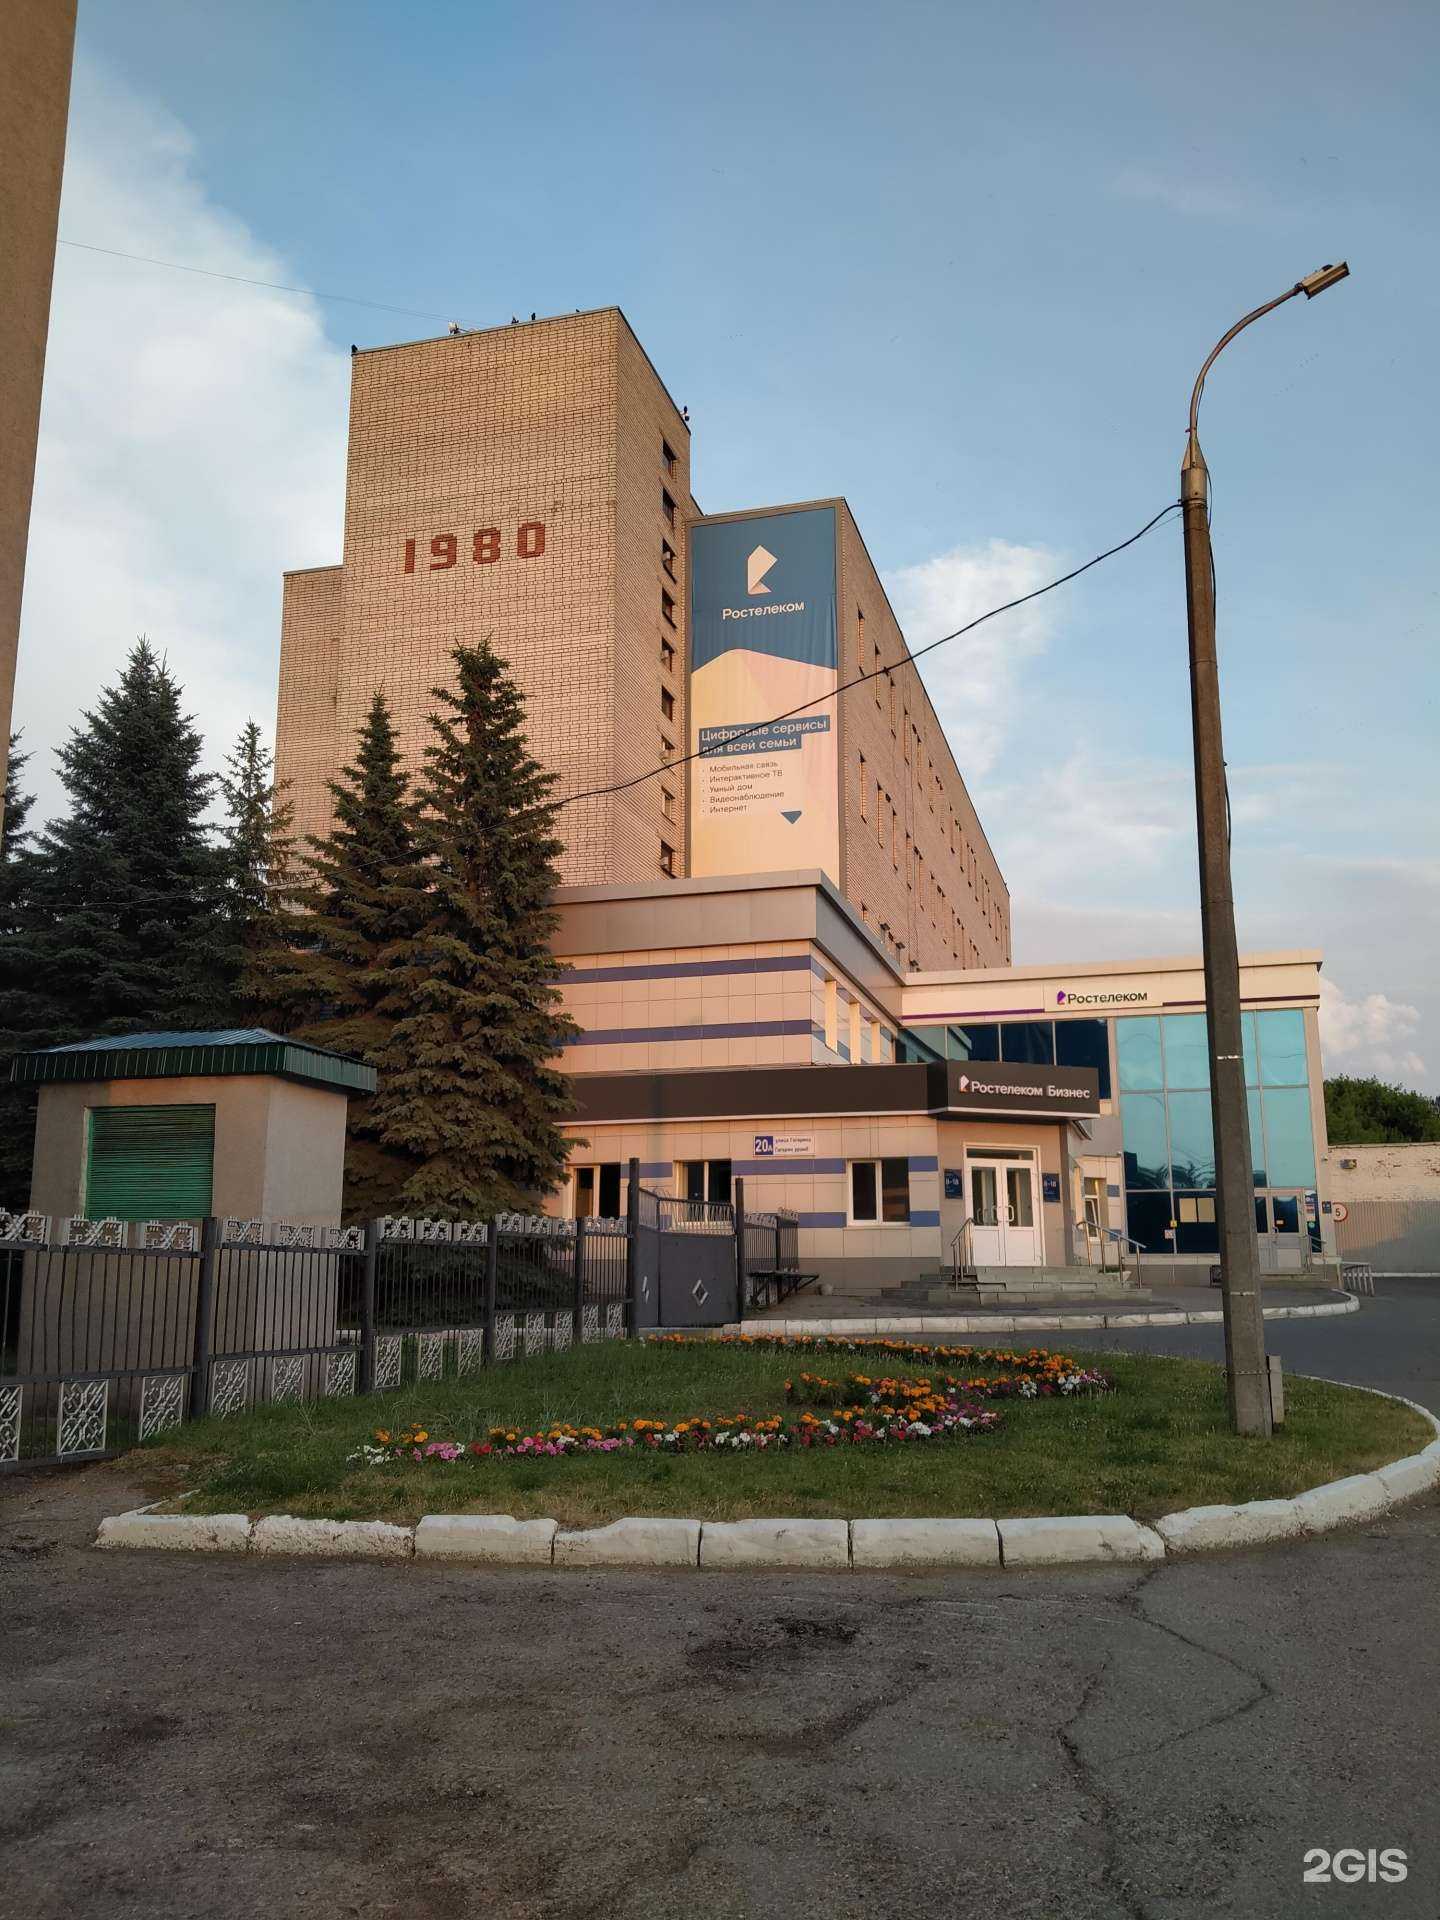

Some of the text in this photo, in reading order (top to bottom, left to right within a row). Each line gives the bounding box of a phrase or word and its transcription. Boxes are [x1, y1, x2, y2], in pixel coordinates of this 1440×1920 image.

[404, 521, 545, 574] 1980
[722, 601, 804, 620] Ростелеком
[772, 720, 827, 735] сервисы
[727, 740, 756, 752] всей
[760, 738, 797, 749] семьи
[709, 764, 754, 773] Мобильная
[709, 773, 770, 783] Интерактивное
[709, 784, 753, 793] Умный дом
[709, 791, 784, 803] Видеонаблюдение
[709, 805, 747, 814] Интернет
[1067, 991, 1148, 1005] Ростелеком
[971, 1080, 1090, 1099] Ростелеком Бизнес
[1335, 1208, 1341, 1217] 5
